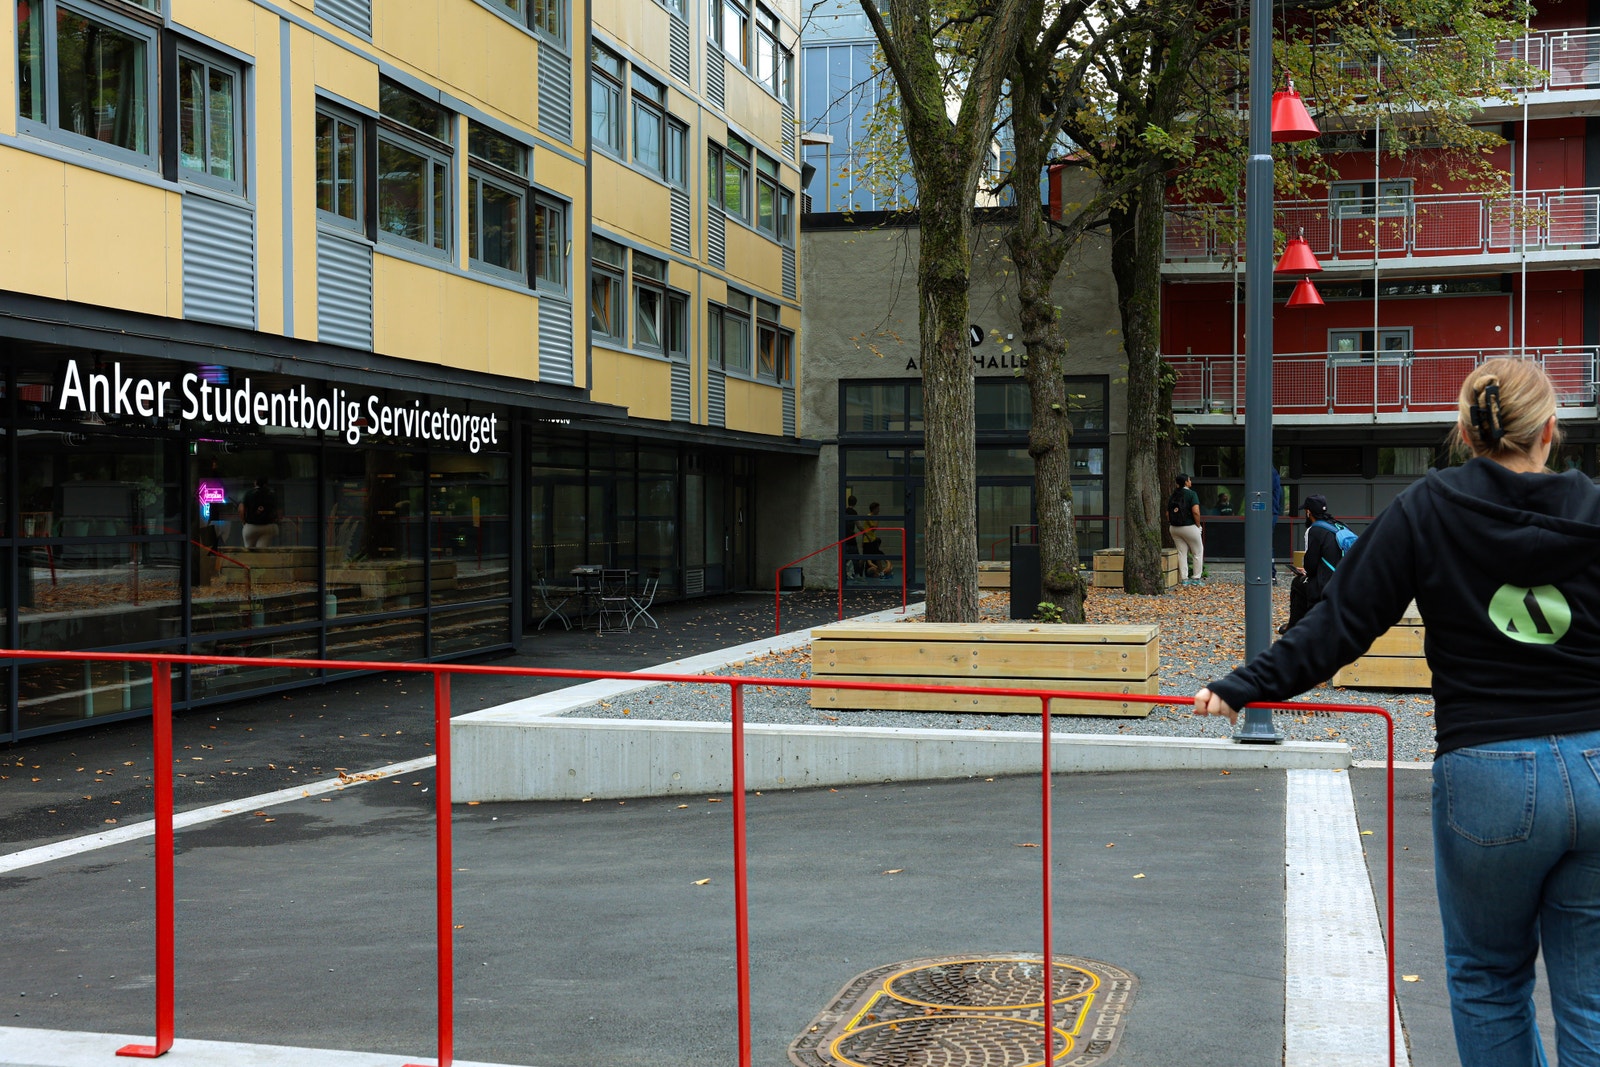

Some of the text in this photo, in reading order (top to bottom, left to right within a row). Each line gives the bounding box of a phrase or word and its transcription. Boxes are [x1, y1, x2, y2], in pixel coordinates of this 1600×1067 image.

[59, 359, 498, 454] Anker Studentbolig Servicetorget
